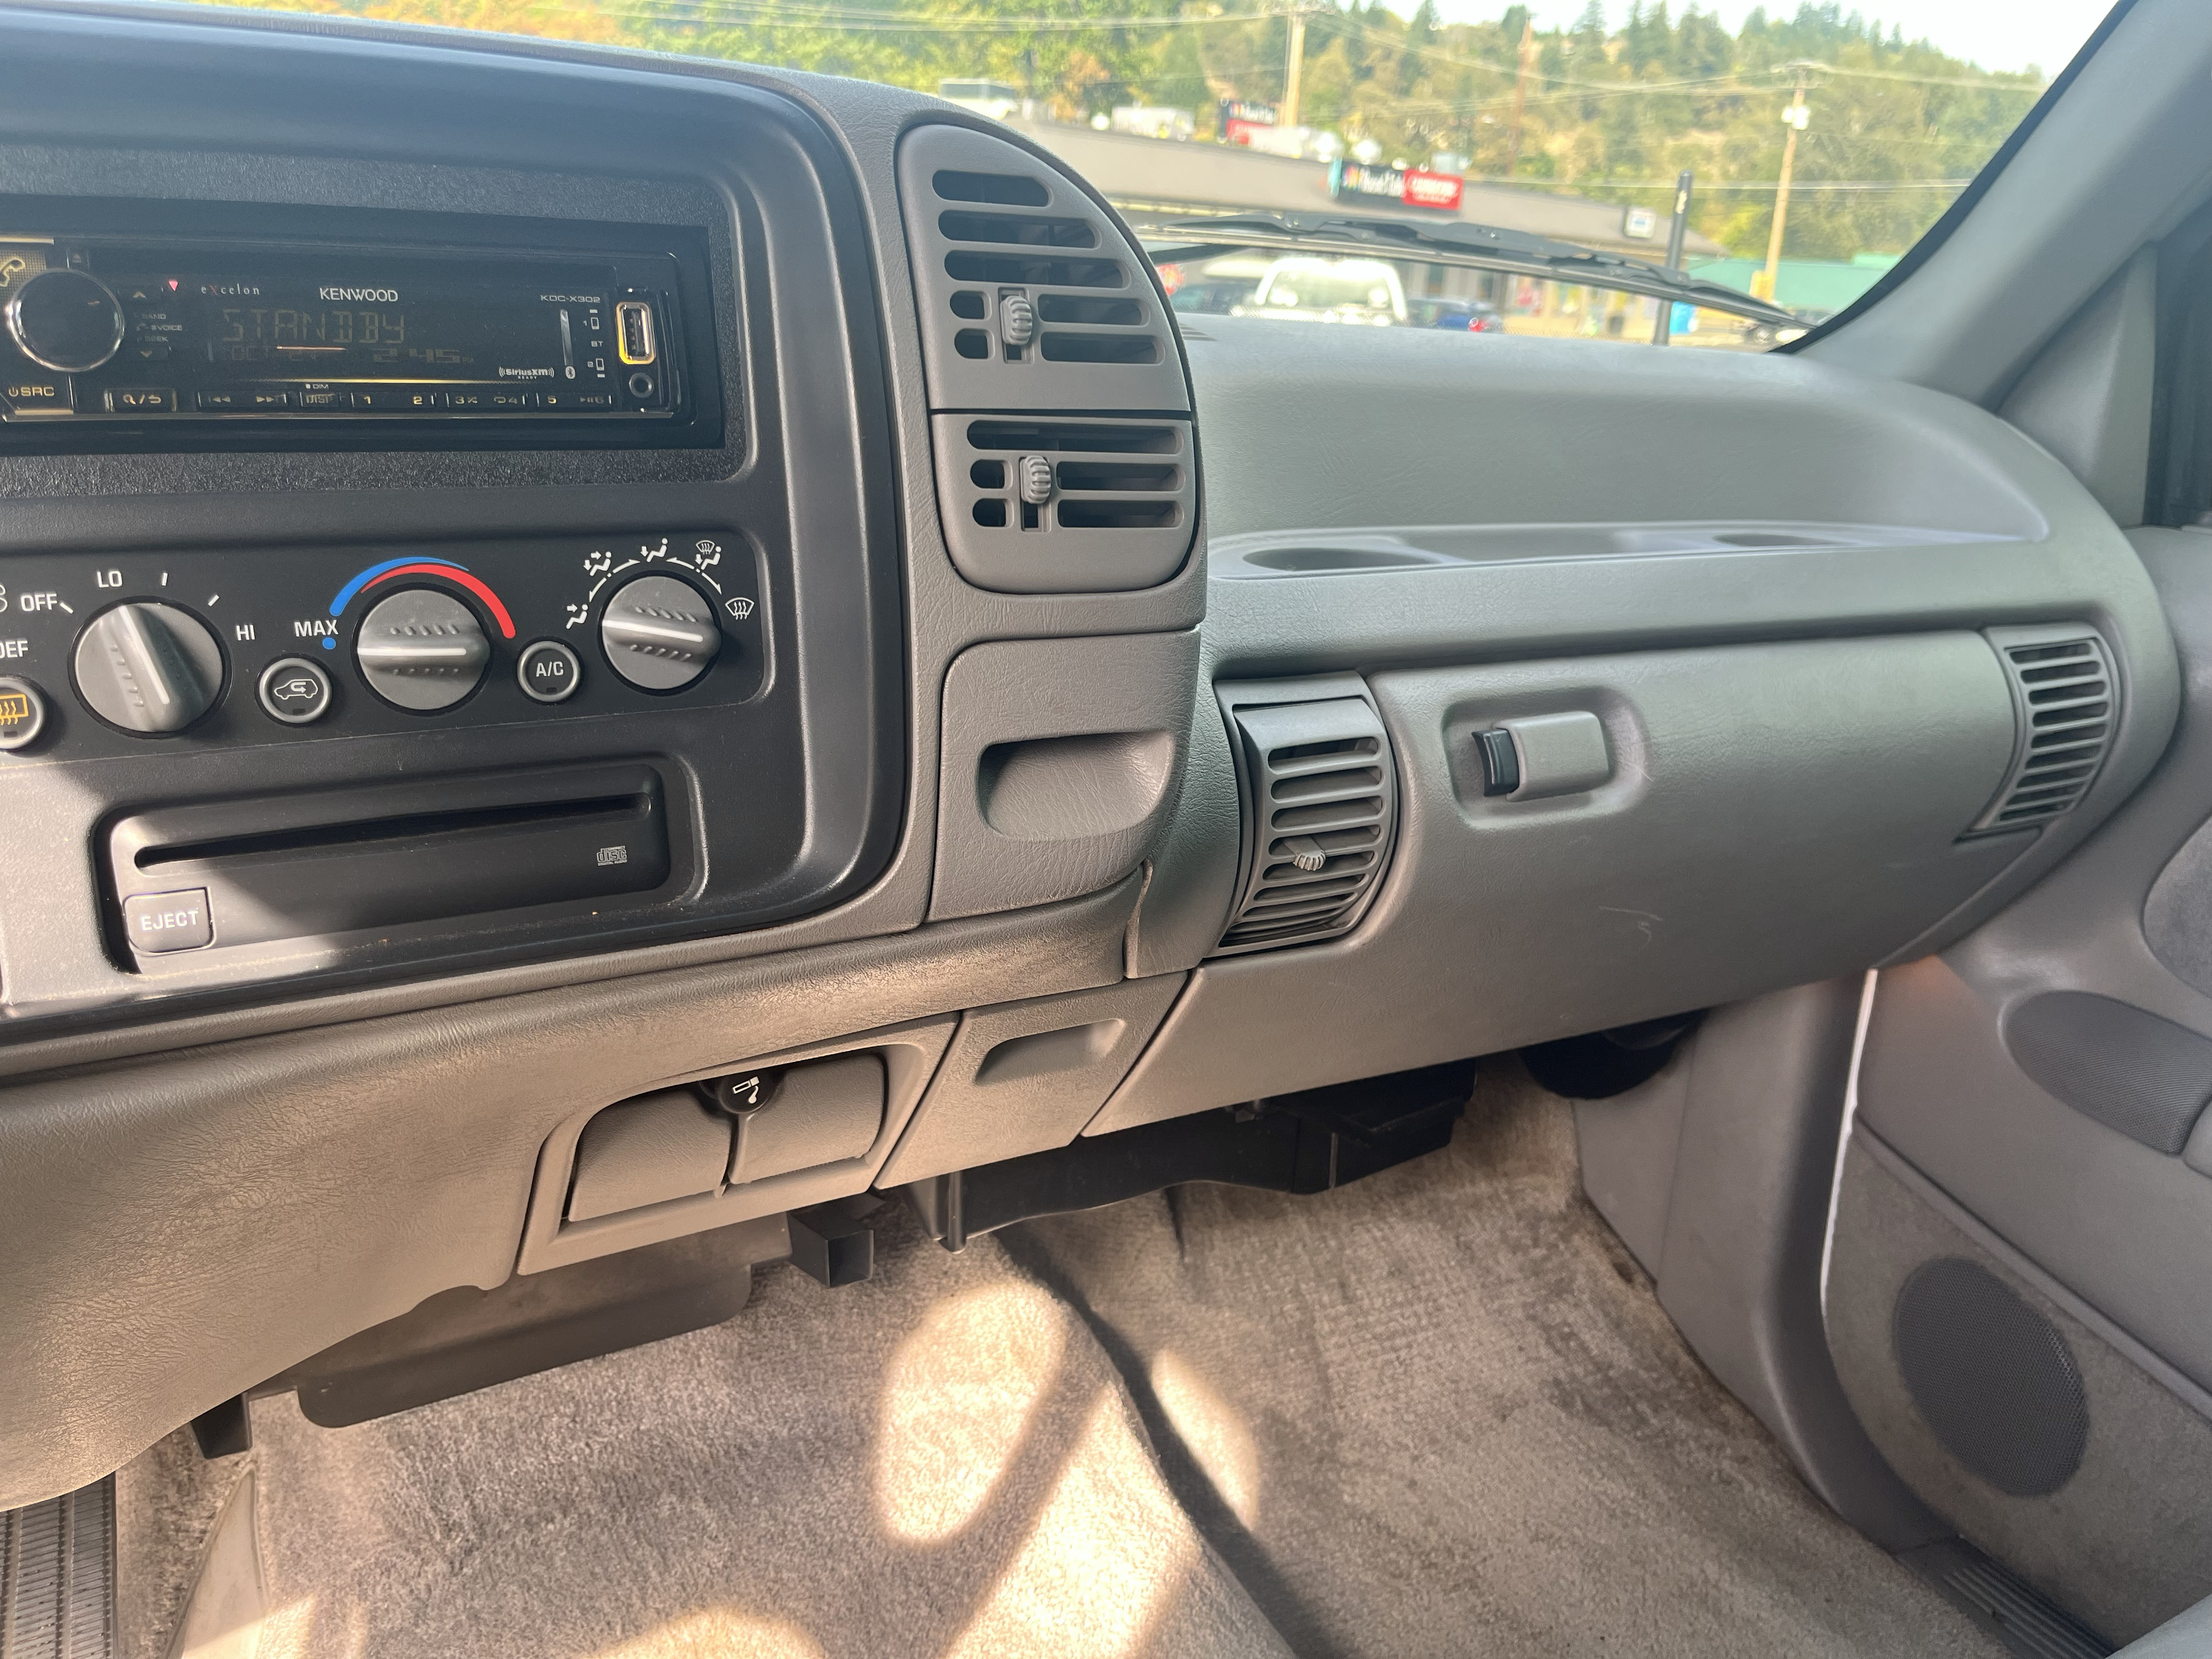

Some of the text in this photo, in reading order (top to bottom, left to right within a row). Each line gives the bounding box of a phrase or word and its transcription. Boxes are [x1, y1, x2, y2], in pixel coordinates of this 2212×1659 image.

[319, 287, 399, 302] KENWOOD
[540, 295, 601, 303] KDC-X302
[222, 308, 405, 344] STANDBY
[20, 387, 55, 397] SRC
[364, 396, 371, 404] 1
[413, 396, 422, 405] 2
[455, 396, 465, 404] 3
[548, 396, 557, 404] 5
[97, 571, 123, 588] LO
[20, 592, 58, 612] OFF
[236, 624, 256, 641] HI
[294, 619, 339, 637] MAX
[536, 661, 564, 677] A/C
[140, 910, 199, 931] EJECT
